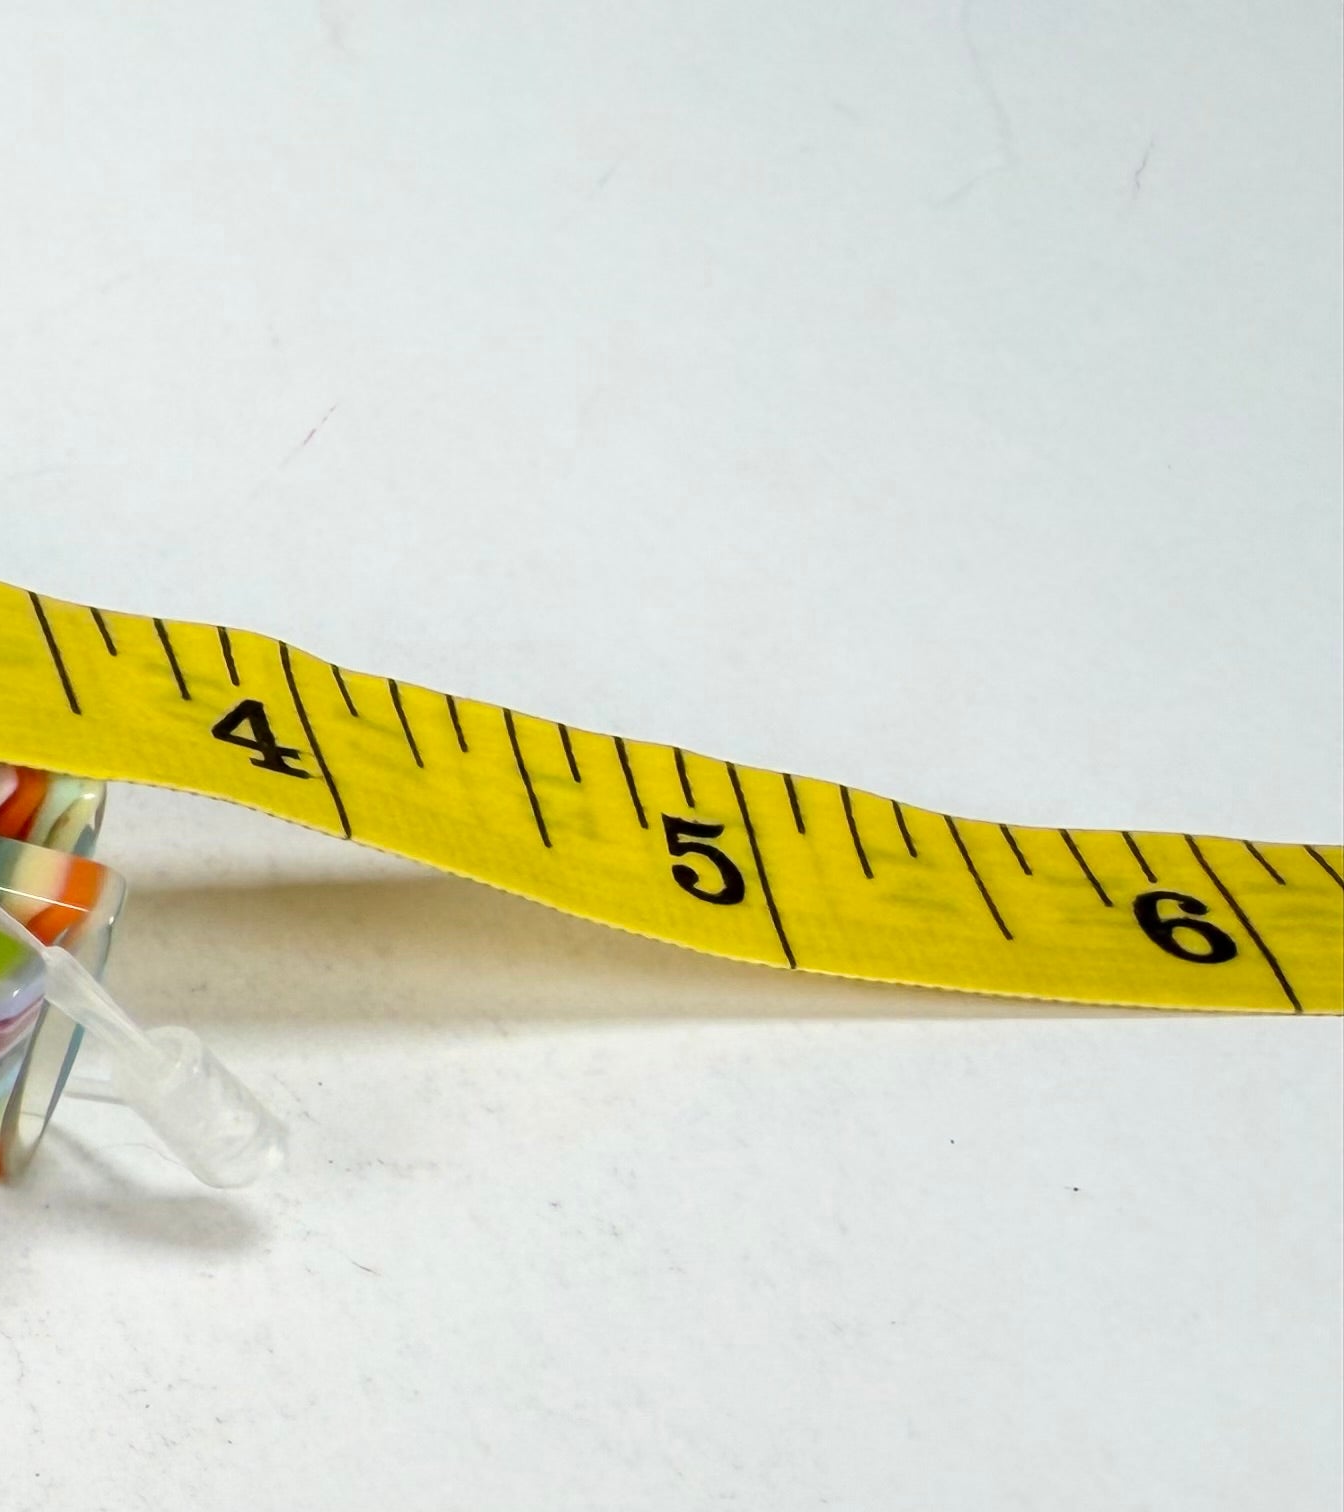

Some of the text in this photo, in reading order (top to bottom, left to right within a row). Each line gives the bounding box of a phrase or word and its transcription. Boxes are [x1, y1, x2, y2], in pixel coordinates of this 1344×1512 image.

[211, 699, 313, 780] 4
[661, 813, 748, 906] 5
[1132, 891, 1238, 965] 6
